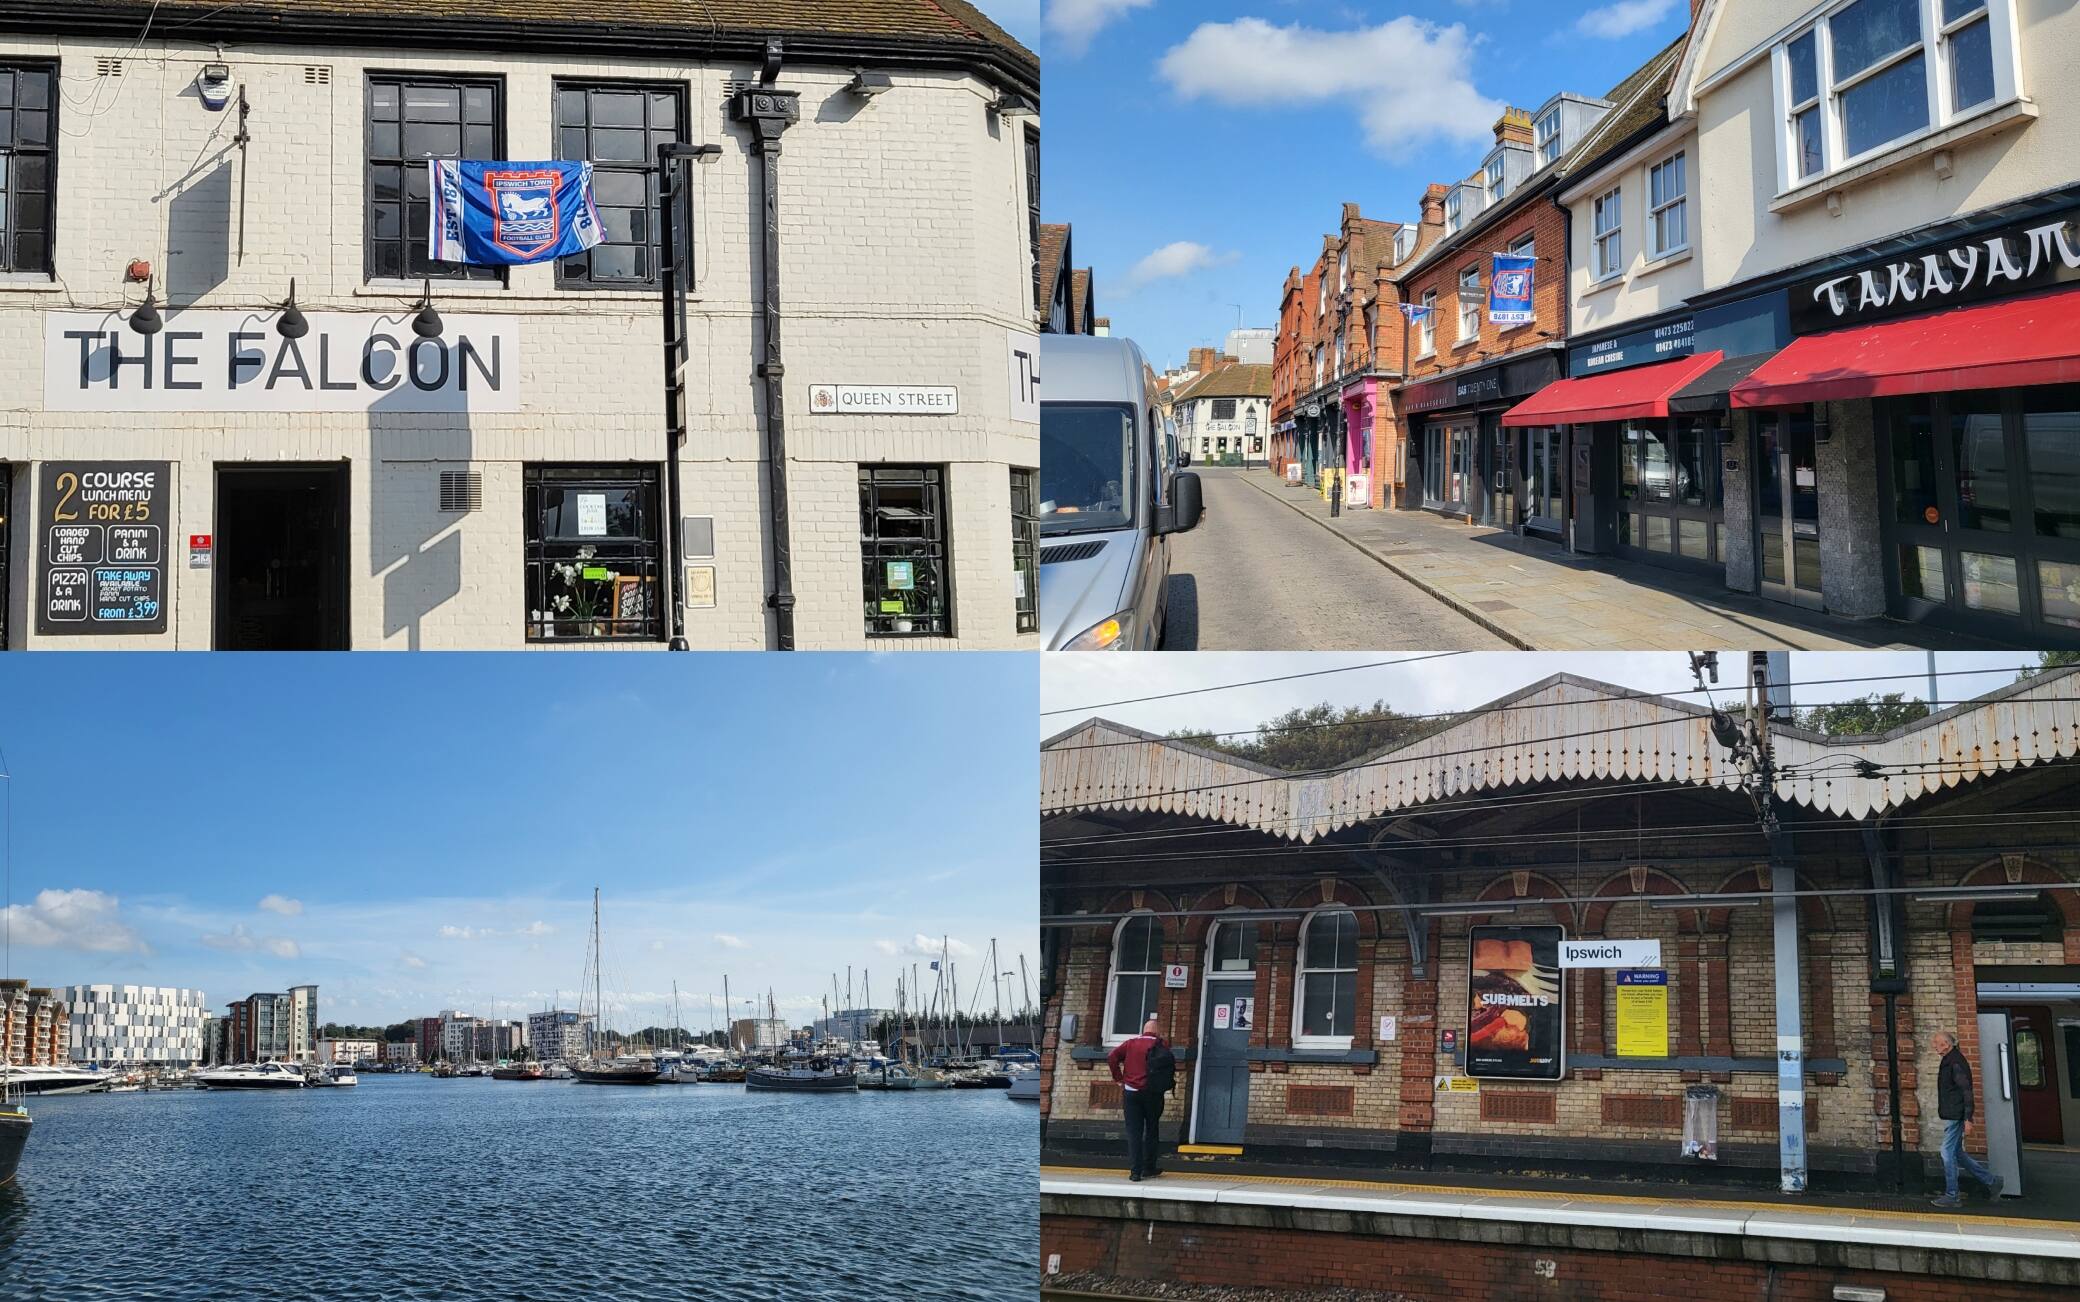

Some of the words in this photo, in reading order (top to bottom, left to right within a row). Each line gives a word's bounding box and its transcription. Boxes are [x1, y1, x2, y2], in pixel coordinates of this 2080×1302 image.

[496, 180, 528, 188] IPSWICH
[1592, 341, 1613, 354] JAPANESE
[64, 330, 203, 390] THE
[227, 331, 501, 392] FALCON
[842, 393, 891, 406] QUEEN
[898, 393, 953, 406] STREET
[55, 472, 79, 522] 2
[82, 472, 155, 488] COURSE
[82, 489, 116, 501] LUNCH
[118, 489, 151, 501] MENU
[89, 504, 120, 520] FOR
[124, 501, 150, 520] £5
[55, 528, 90, 537] LOADED
[114, 529, 148, 539] PANINI
[60, 537, 85, 545] HAND
[122, 539, 129, 547] &
[131, 539, 138, 547] A
[60, 545, 79, 553] CUT
[115, 547, 147, 560] DRINK
[57, 553, 82, 562] CHIPS
[52, 573, 86, 585] PIZZA
[96, 571, 122, 581] TAKE
[123, 571, 151, 581] AWAY
[55, 587, 63, 596] &
[65, 587, 72, 596] A
[51, 599, 81, 611] DRINK
[99, 608, 126, 619] FROM
[1566, 945, 1622, 962] Ipswich
